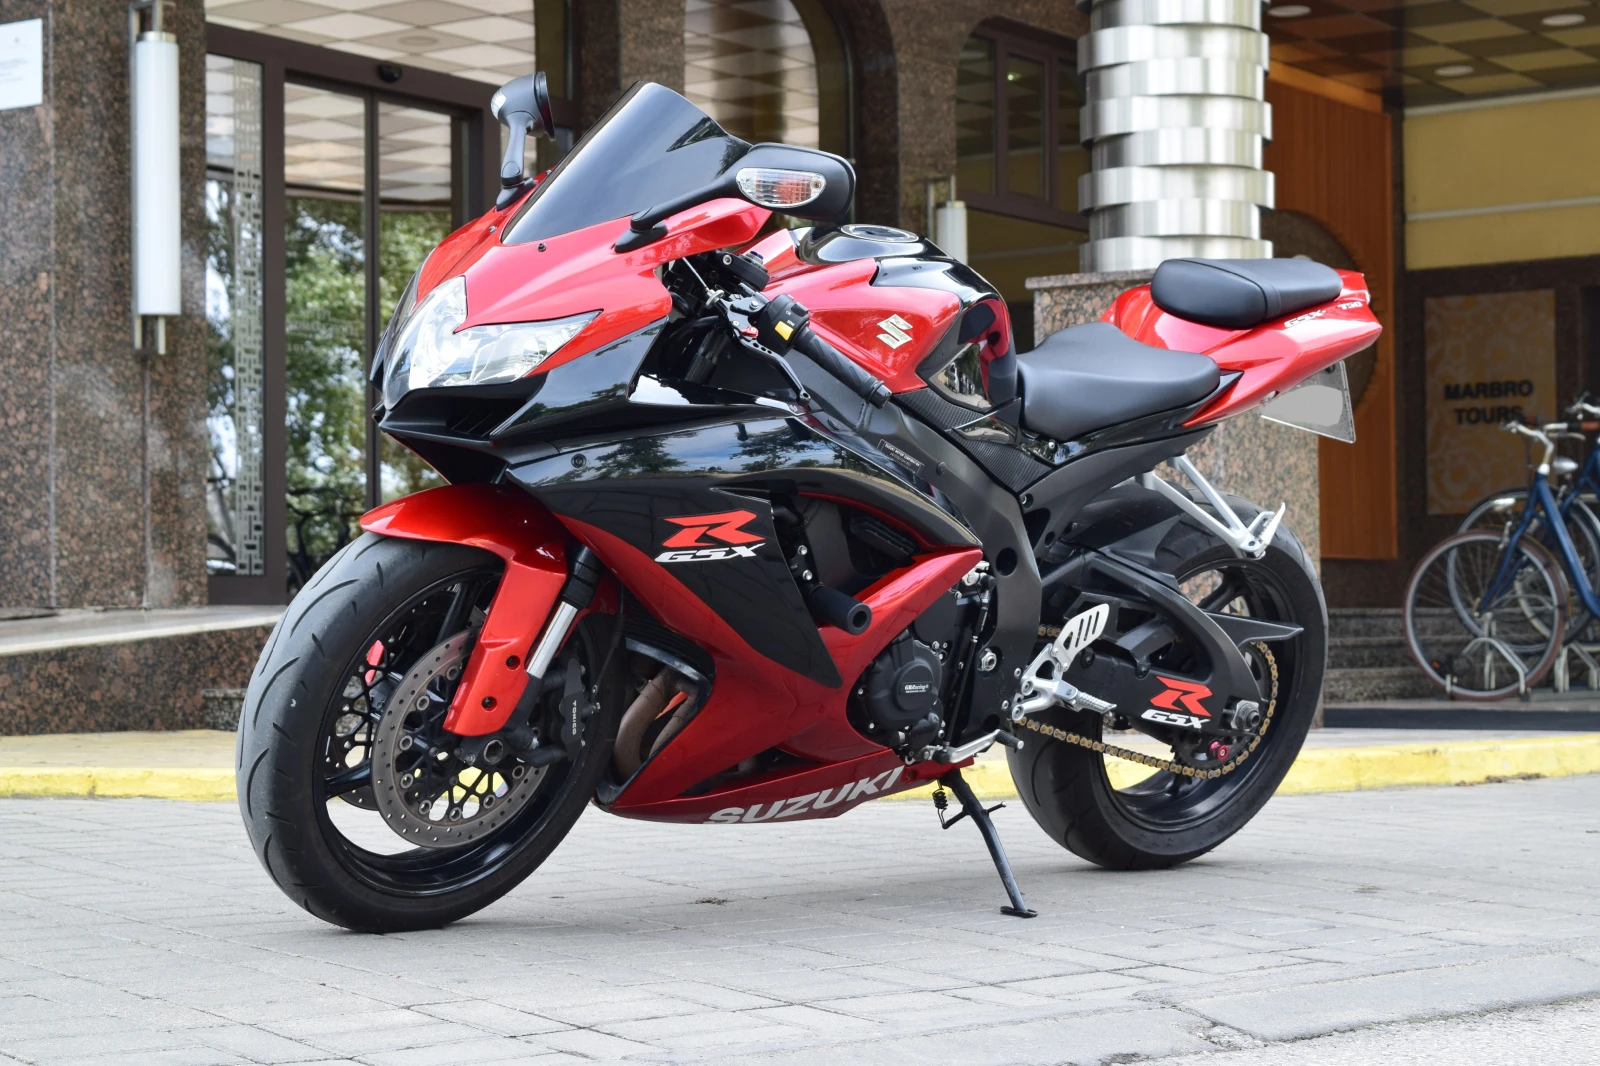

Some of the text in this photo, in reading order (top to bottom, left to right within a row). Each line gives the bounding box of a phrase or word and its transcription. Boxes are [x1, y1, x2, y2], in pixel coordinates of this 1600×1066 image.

[1443, 380, 1534, 399] MARBRO
[1454, 405, 1523, 424] TOURS
[662, 509, 766, 548] R
[654, 542, 766, 563] GSX
[1150, 675, 1213, 717] R
[1140, 709, 1211, 729] GSX
[703, 765, 904, 824] SUZUKI
